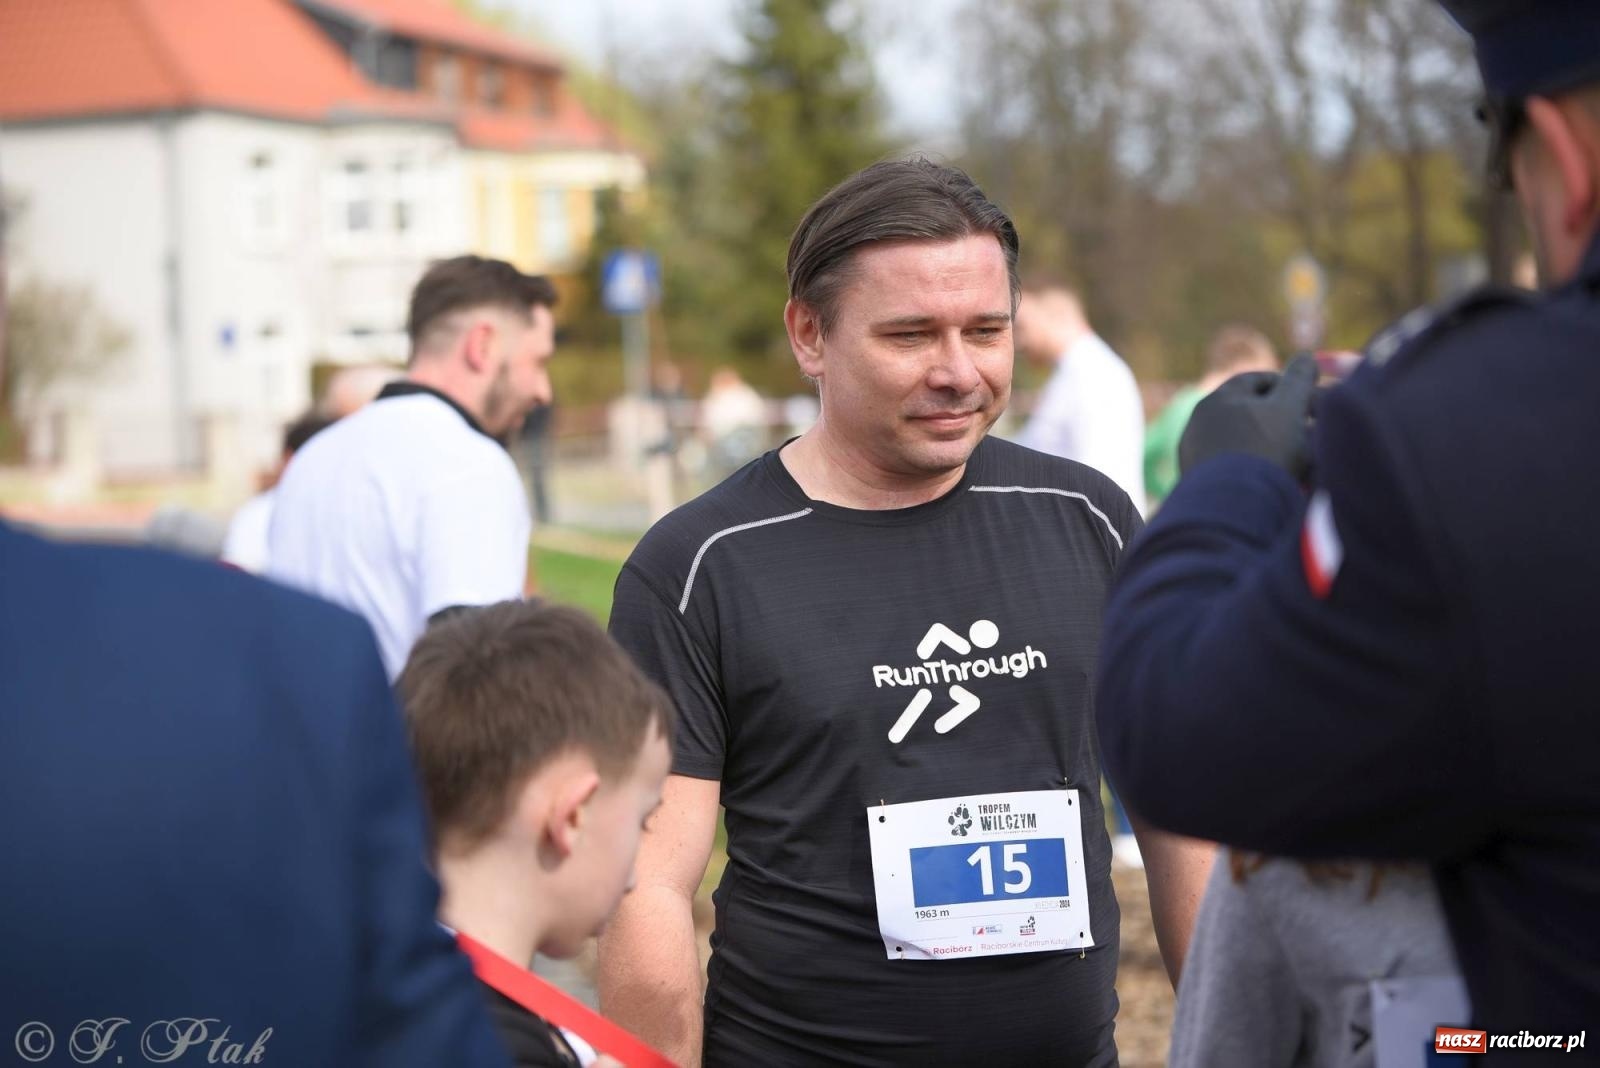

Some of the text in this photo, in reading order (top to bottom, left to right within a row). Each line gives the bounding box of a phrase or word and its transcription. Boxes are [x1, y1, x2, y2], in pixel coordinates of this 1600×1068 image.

[872, 645, 1047, 688] RunThrough
[978, 803, 1011, 814] TROPEM
[980, 813, 1037, 831] WILCZYM
[966, 843, 1032, 896] 15
[915, 910, 937, 919] 1963
